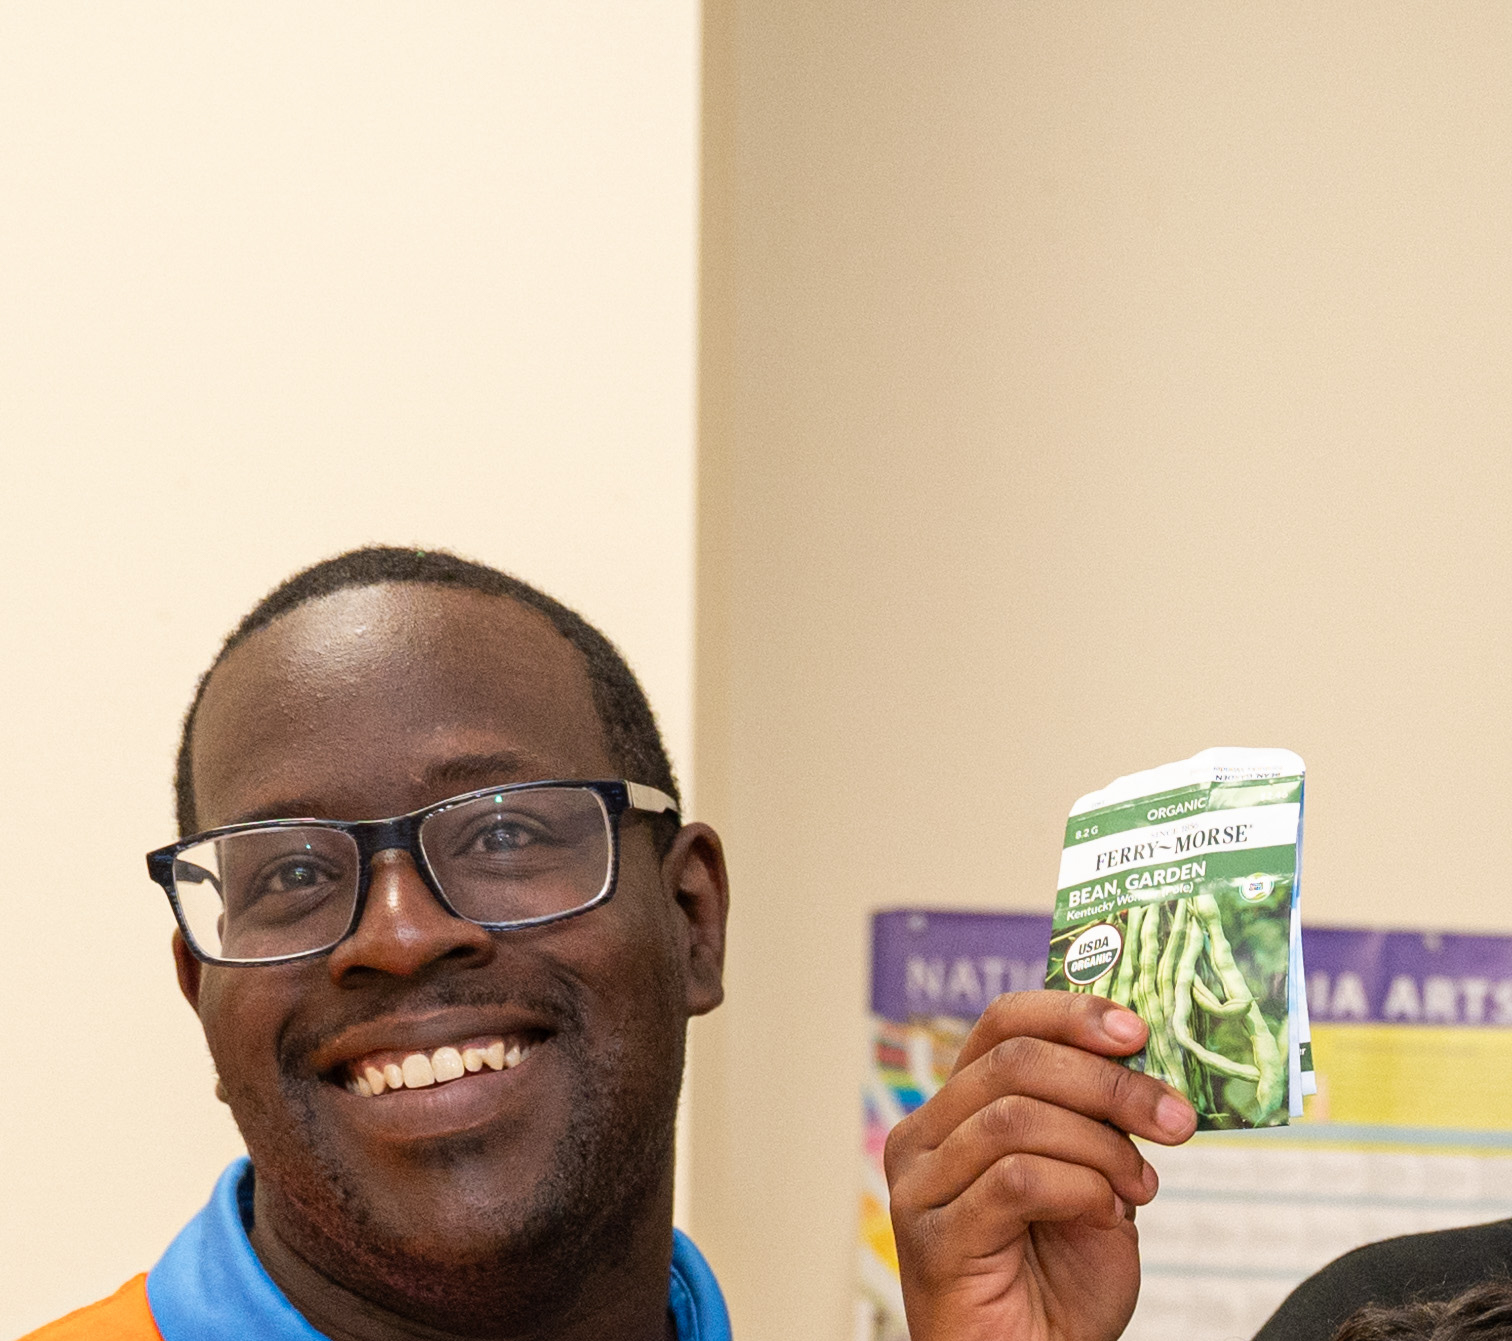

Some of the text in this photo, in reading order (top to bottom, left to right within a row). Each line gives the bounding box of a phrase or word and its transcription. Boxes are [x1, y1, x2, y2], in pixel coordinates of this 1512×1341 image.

[1147, 797, 1208, 821] ORGANIC
[1075, 827, 1090, 840] 8.2
[1068, 860, 1207, 907] BEAN, GARDEN
[1066, 900, 1116, 921] Kentucky
[1078, 936, 1109, 956] USDA
[1070, 952, 1113, 973] ORGANIC
